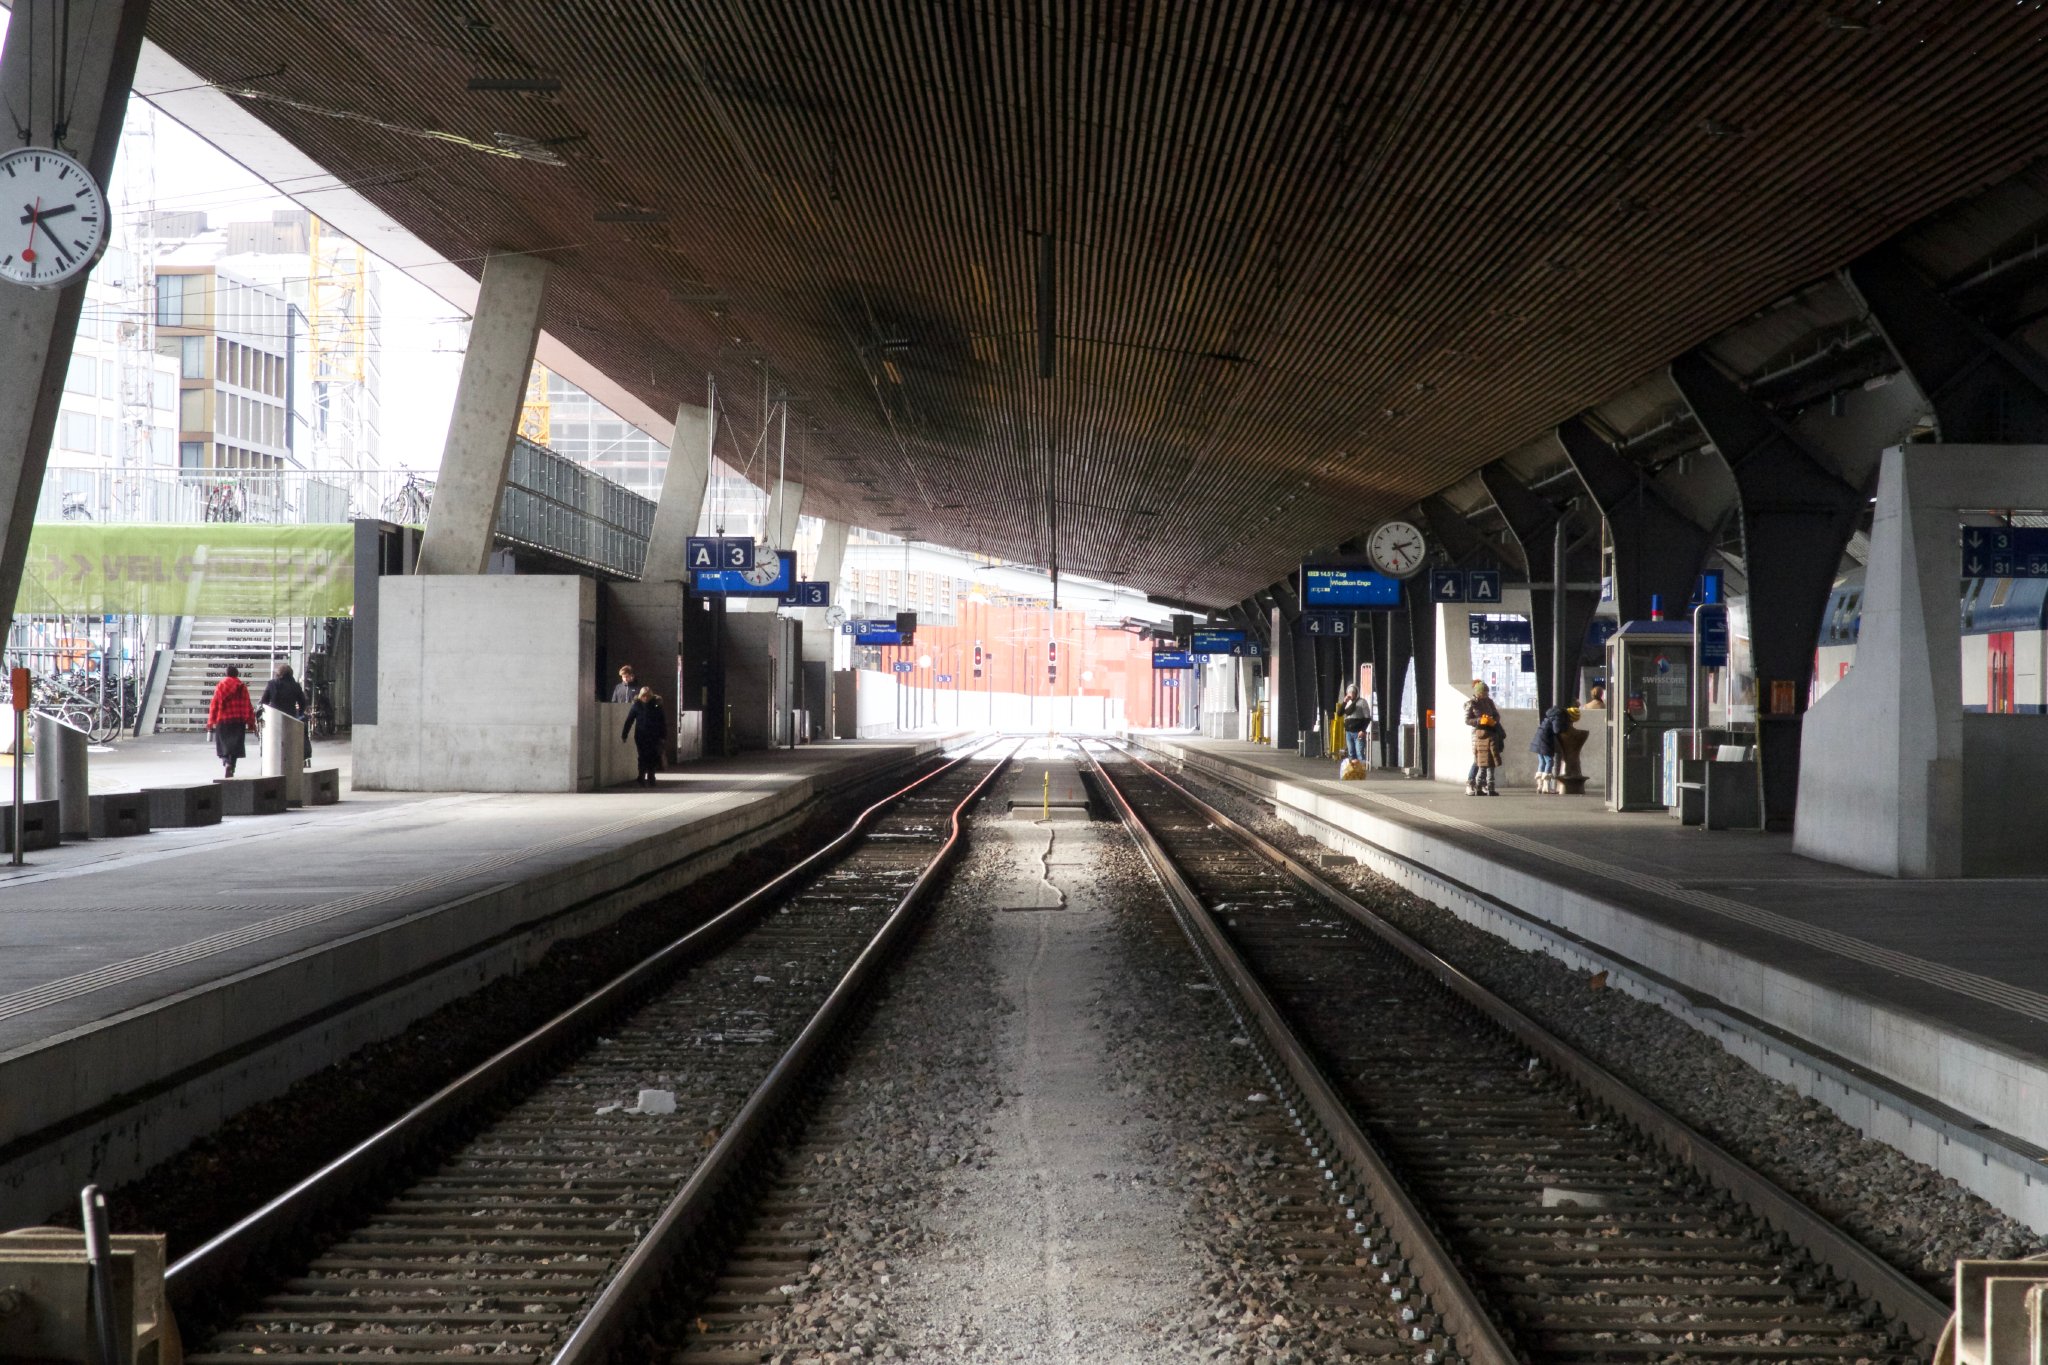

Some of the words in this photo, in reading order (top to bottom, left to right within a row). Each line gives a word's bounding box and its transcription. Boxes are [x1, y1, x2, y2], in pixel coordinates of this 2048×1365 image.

[1998, 535, 2008, 548] 3
[695, 547, 711, 565] A
[731, 547, 745, 565] 3
[1994, 562, 2009, 574] 31
[2031, 562, 2048, 574] 34
[1441, 579, 1455, 597] 4
[1477, 580, 1492, 597] A
[811, 589, 822, 603] 3
[845, 624, 852, 633] B
[860, 625, 867, 633] 3
[1310, 620, 1320, 633] 4
[1334, 621, 1344, 633] B
[1471, 622, 1480, 634] 5
[1233, 645, 1241, 655] 4
[1250, 646, 1258, 655] B
[1188, 654, 1194, 662] 4
[1201, 654, 1208, 662] C
[1642, 676, 1684, 684] swisscom
